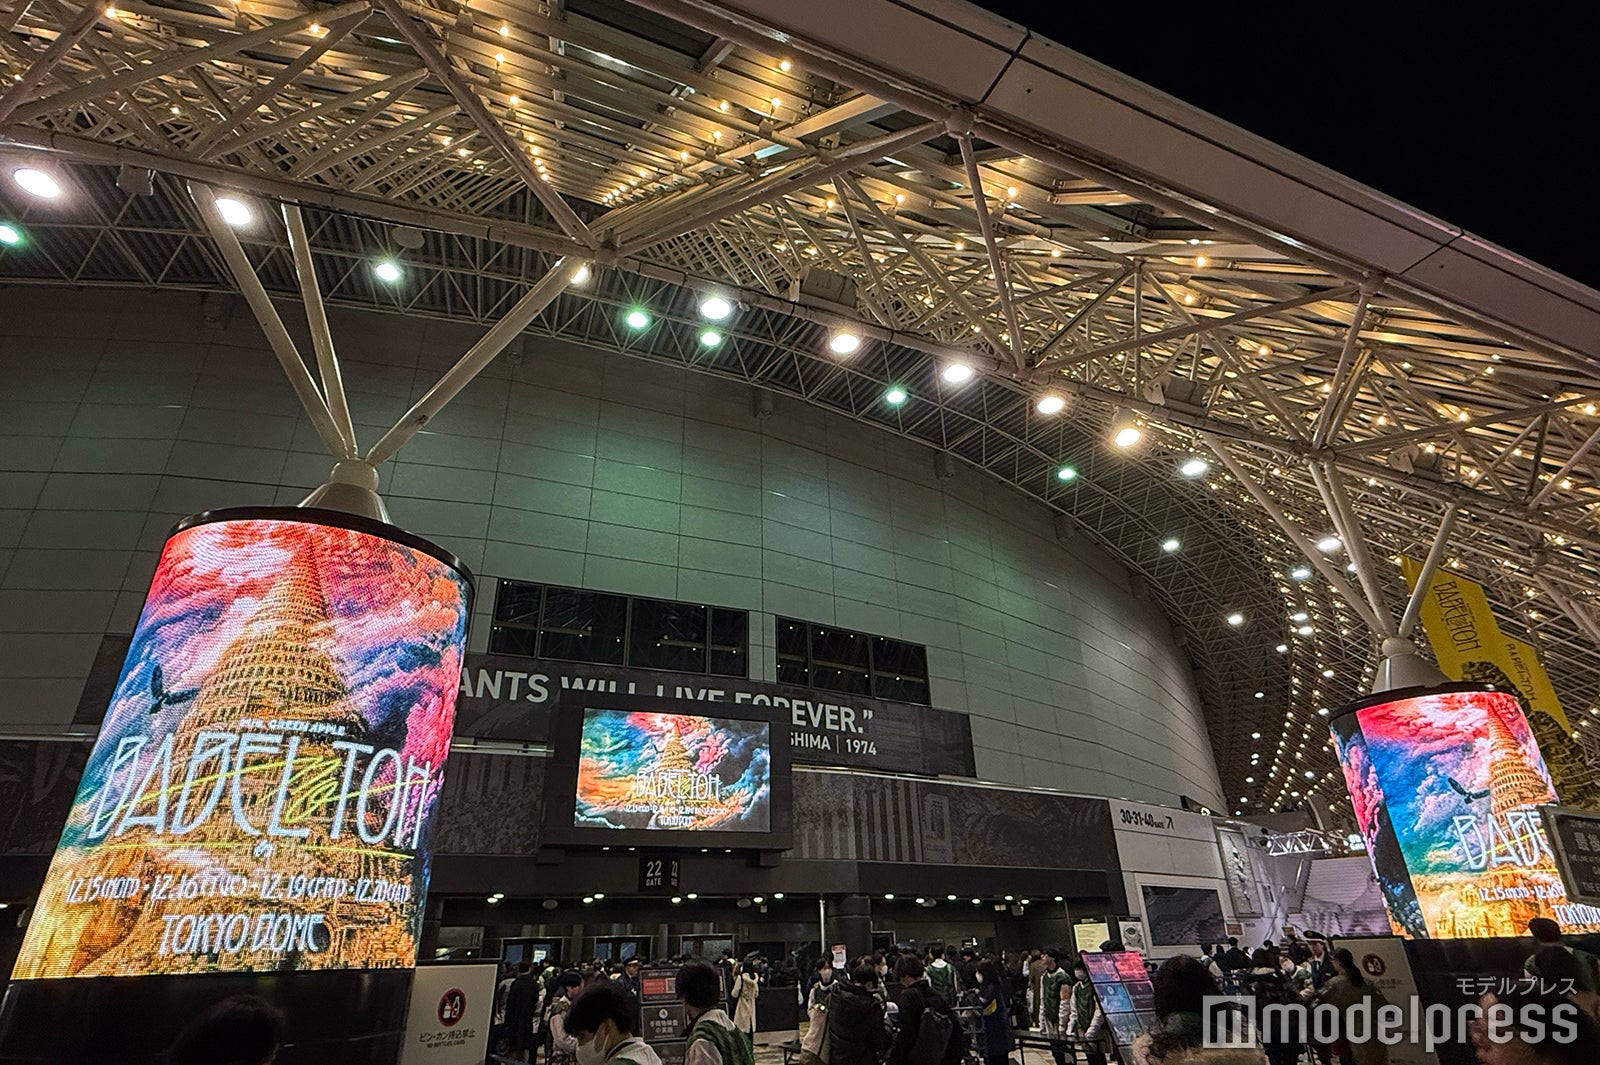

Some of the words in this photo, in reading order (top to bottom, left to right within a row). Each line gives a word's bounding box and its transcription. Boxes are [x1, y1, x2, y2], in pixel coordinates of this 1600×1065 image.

[845, 738, 877, 756] 1974
[87, 730, 311, 839] BABEL
[331, 740, 432, 850] TOH
[635, 771, 688, 800] BABEL
[688, 773, 720, 801] TOH
[646, 860, 662, 877] 22
[645, 877, 662, 887] GATE
[158, 913, 250, 957] TOKYO
[252, 913, 325, 953] DOME
